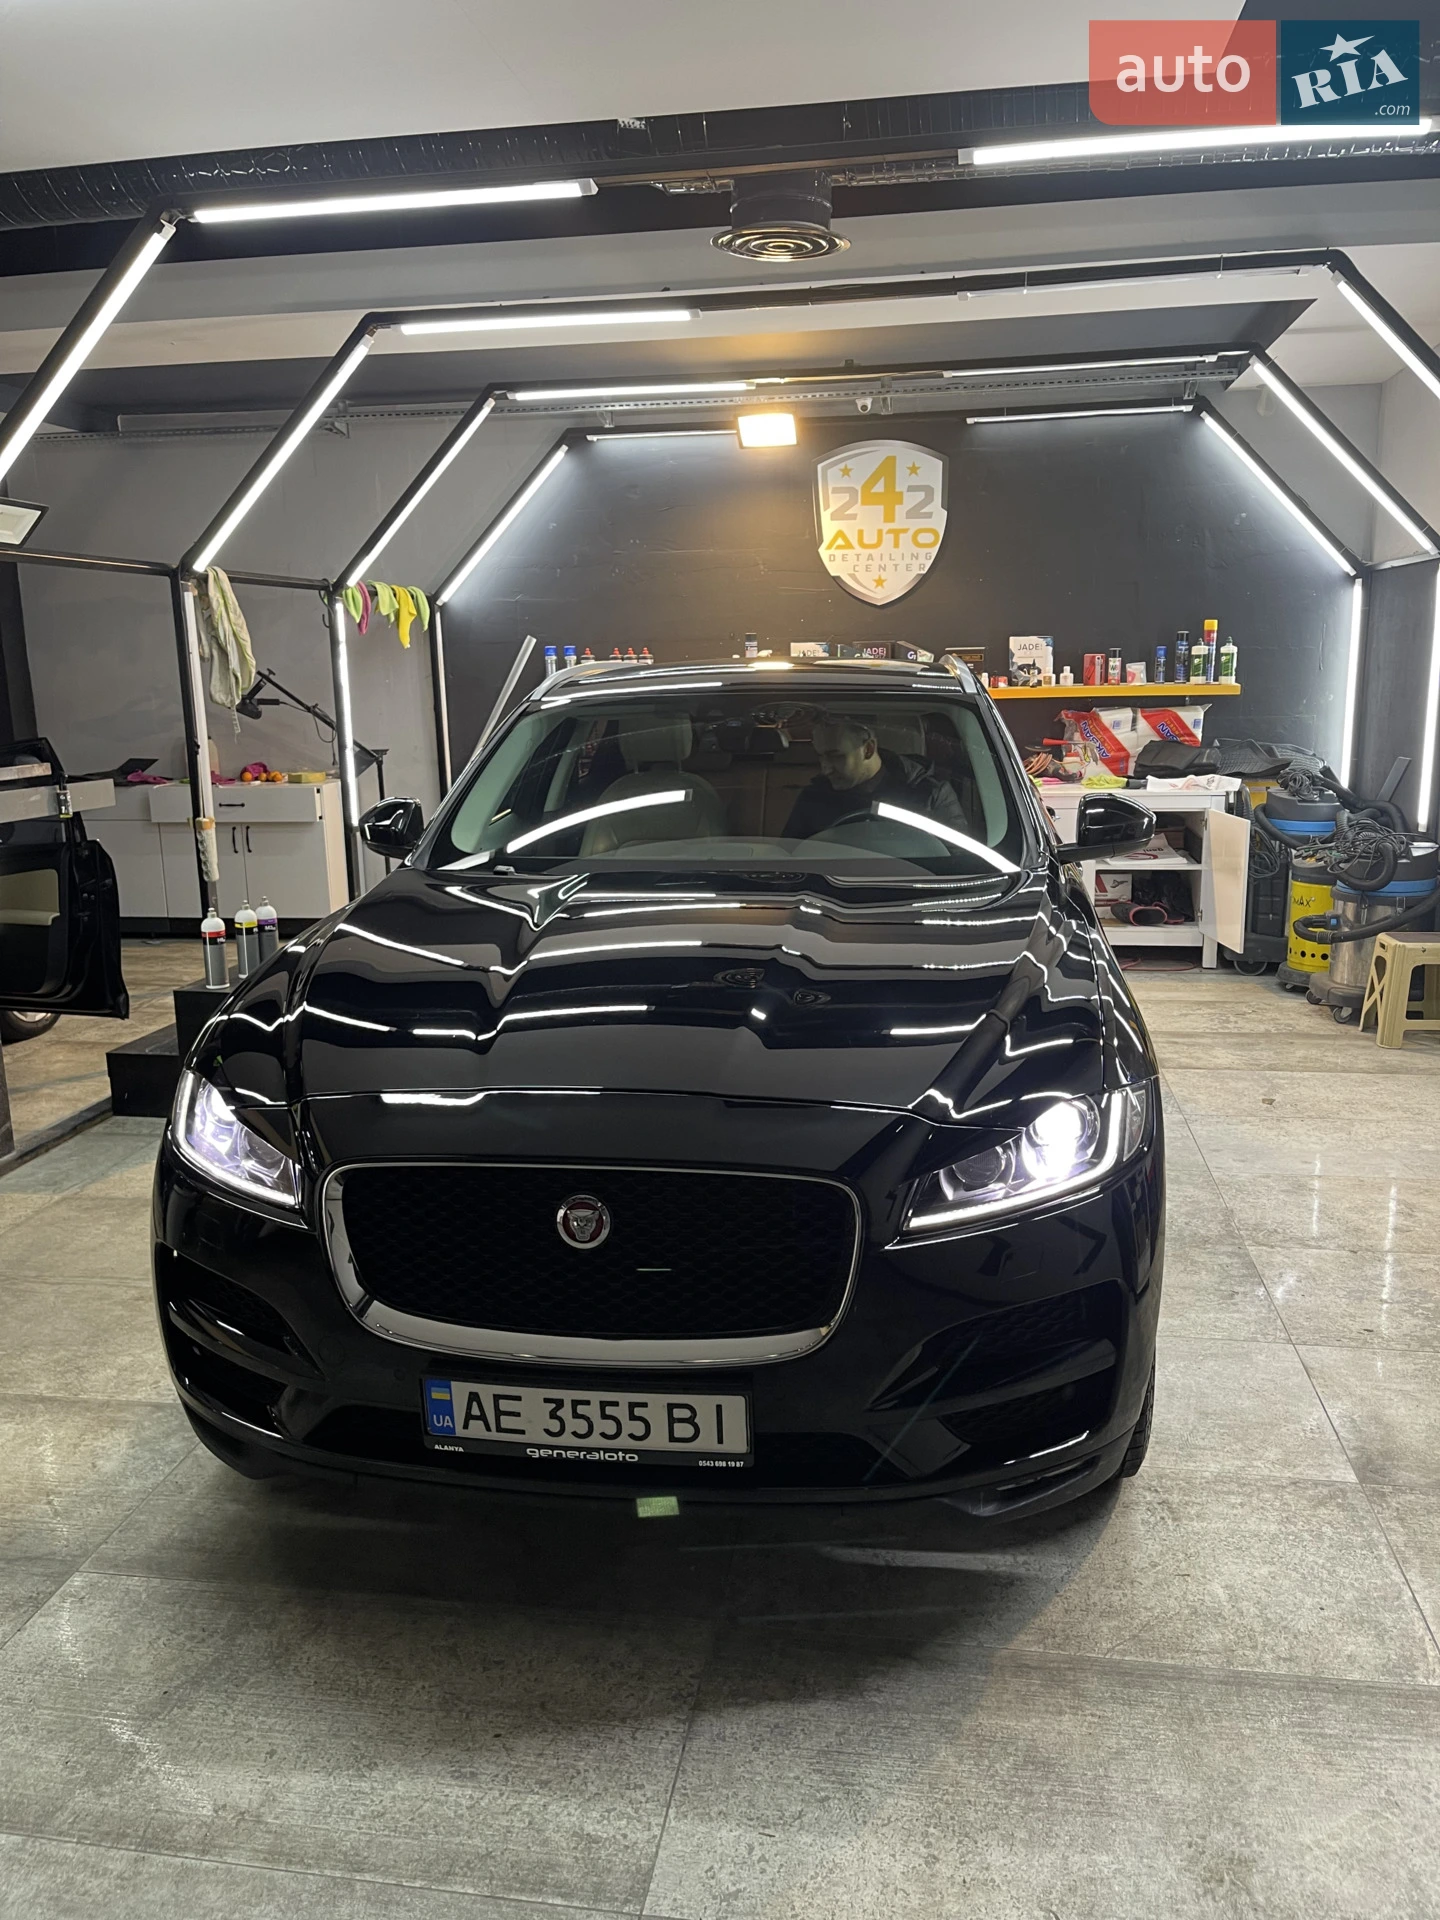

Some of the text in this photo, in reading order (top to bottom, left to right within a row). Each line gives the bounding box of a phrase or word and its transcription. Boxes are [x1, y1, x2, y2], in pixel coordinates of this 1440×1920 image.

[829, 455, 935, 524] 242
[824, 527, 941, 551] AUTO
[828, 551, 933, 563] DETAILING
[852, 562, 927, 573] CENTER
[433, 1414, 454, 1428] UA
[462, 1391, 526, 1435] AE
[543, 1397, 651, 1441] 3555
[434, 1444, 465, 1453] ALANYA
[526, 1448, 639, 1462] generaloto
